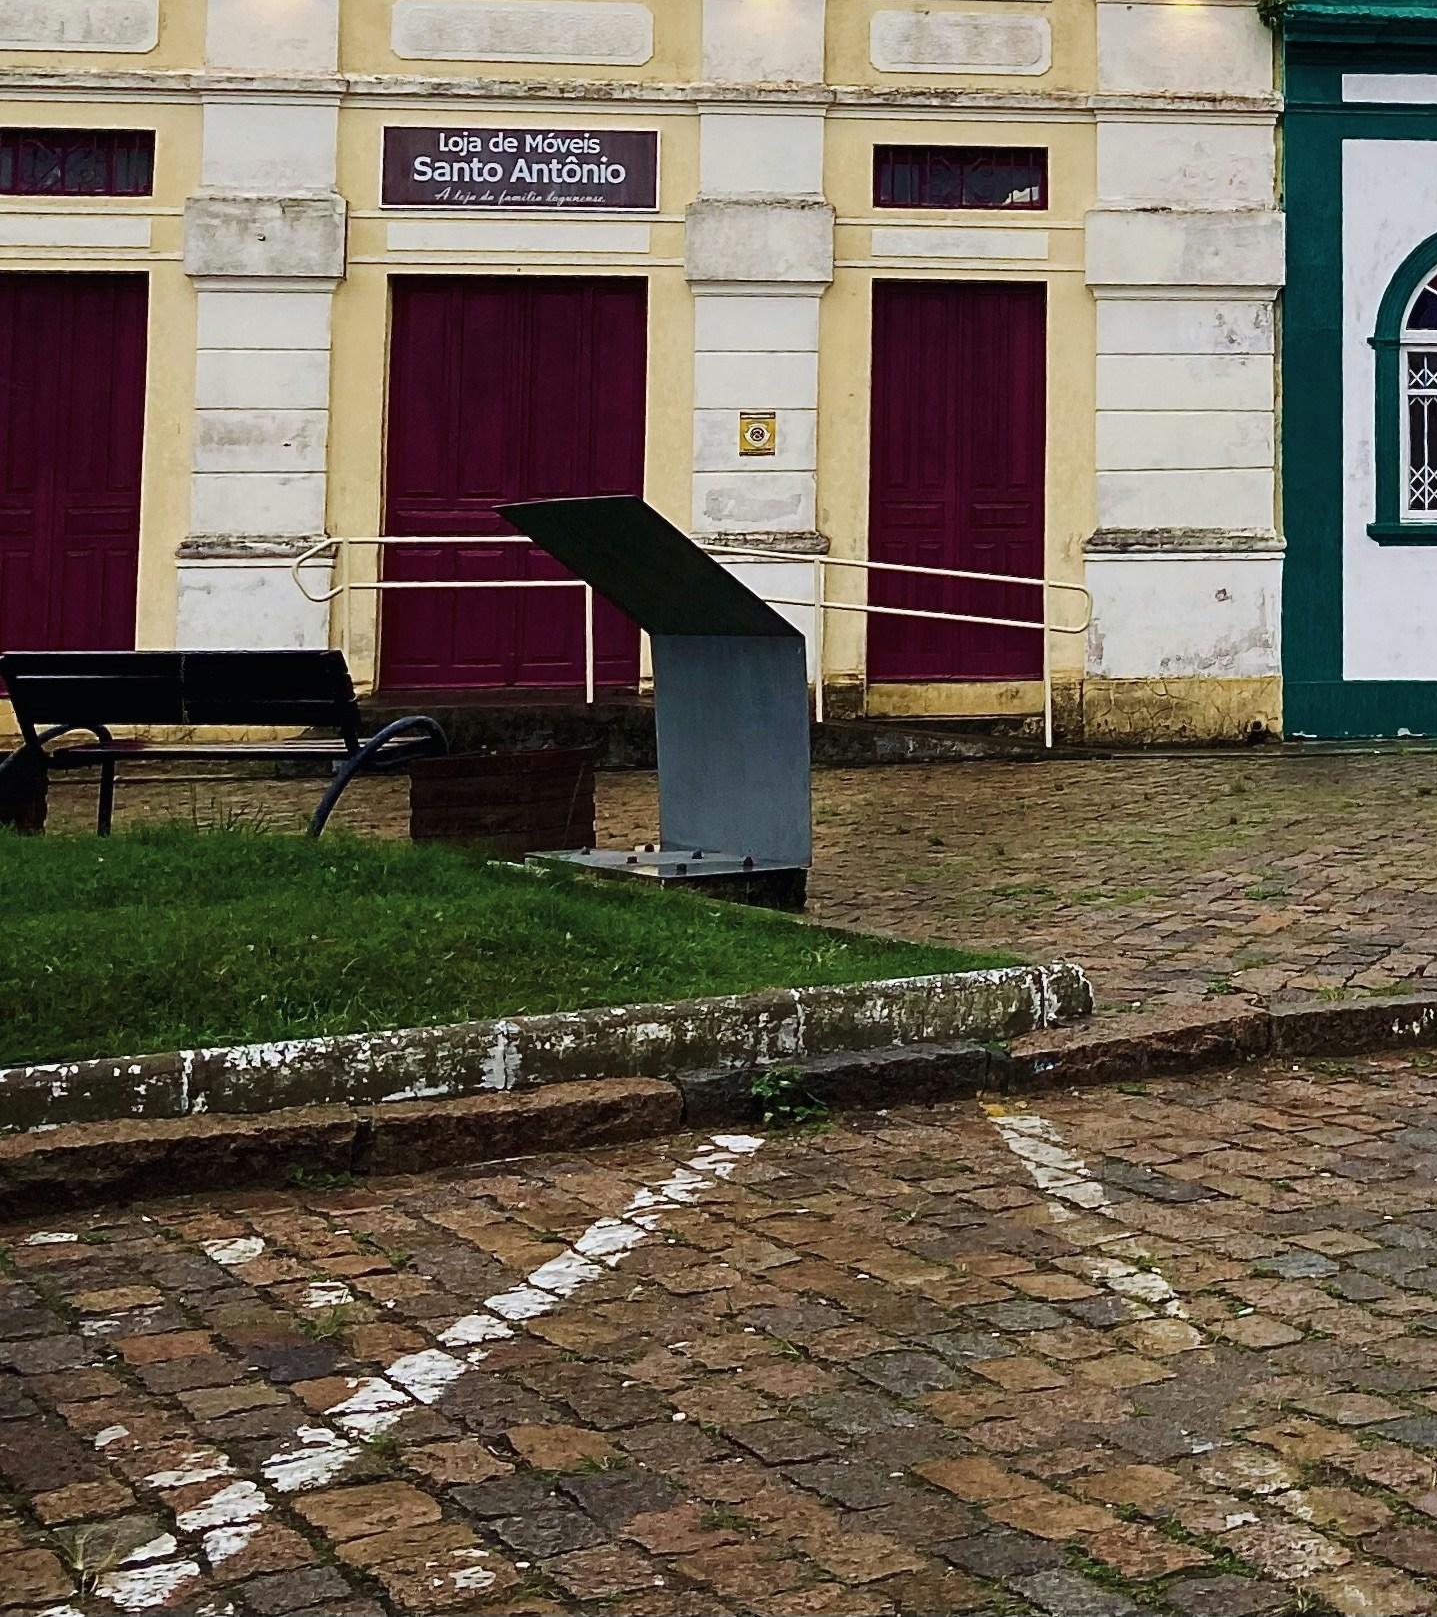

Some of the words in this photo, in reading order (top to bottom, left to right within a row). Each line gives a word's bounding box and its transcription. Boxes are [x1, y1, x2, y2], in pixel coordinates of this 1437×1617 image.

[439, 132, 482, 156] Loja
[488, 132, 518, 153] de
[525, 132, 601, 154] Móveis
[413, 156, 504, 183] Santo
[509, 156, 626, 184] Antônio
[434, 186, 451, 200] A
[452, 189, 477, 205] loja
